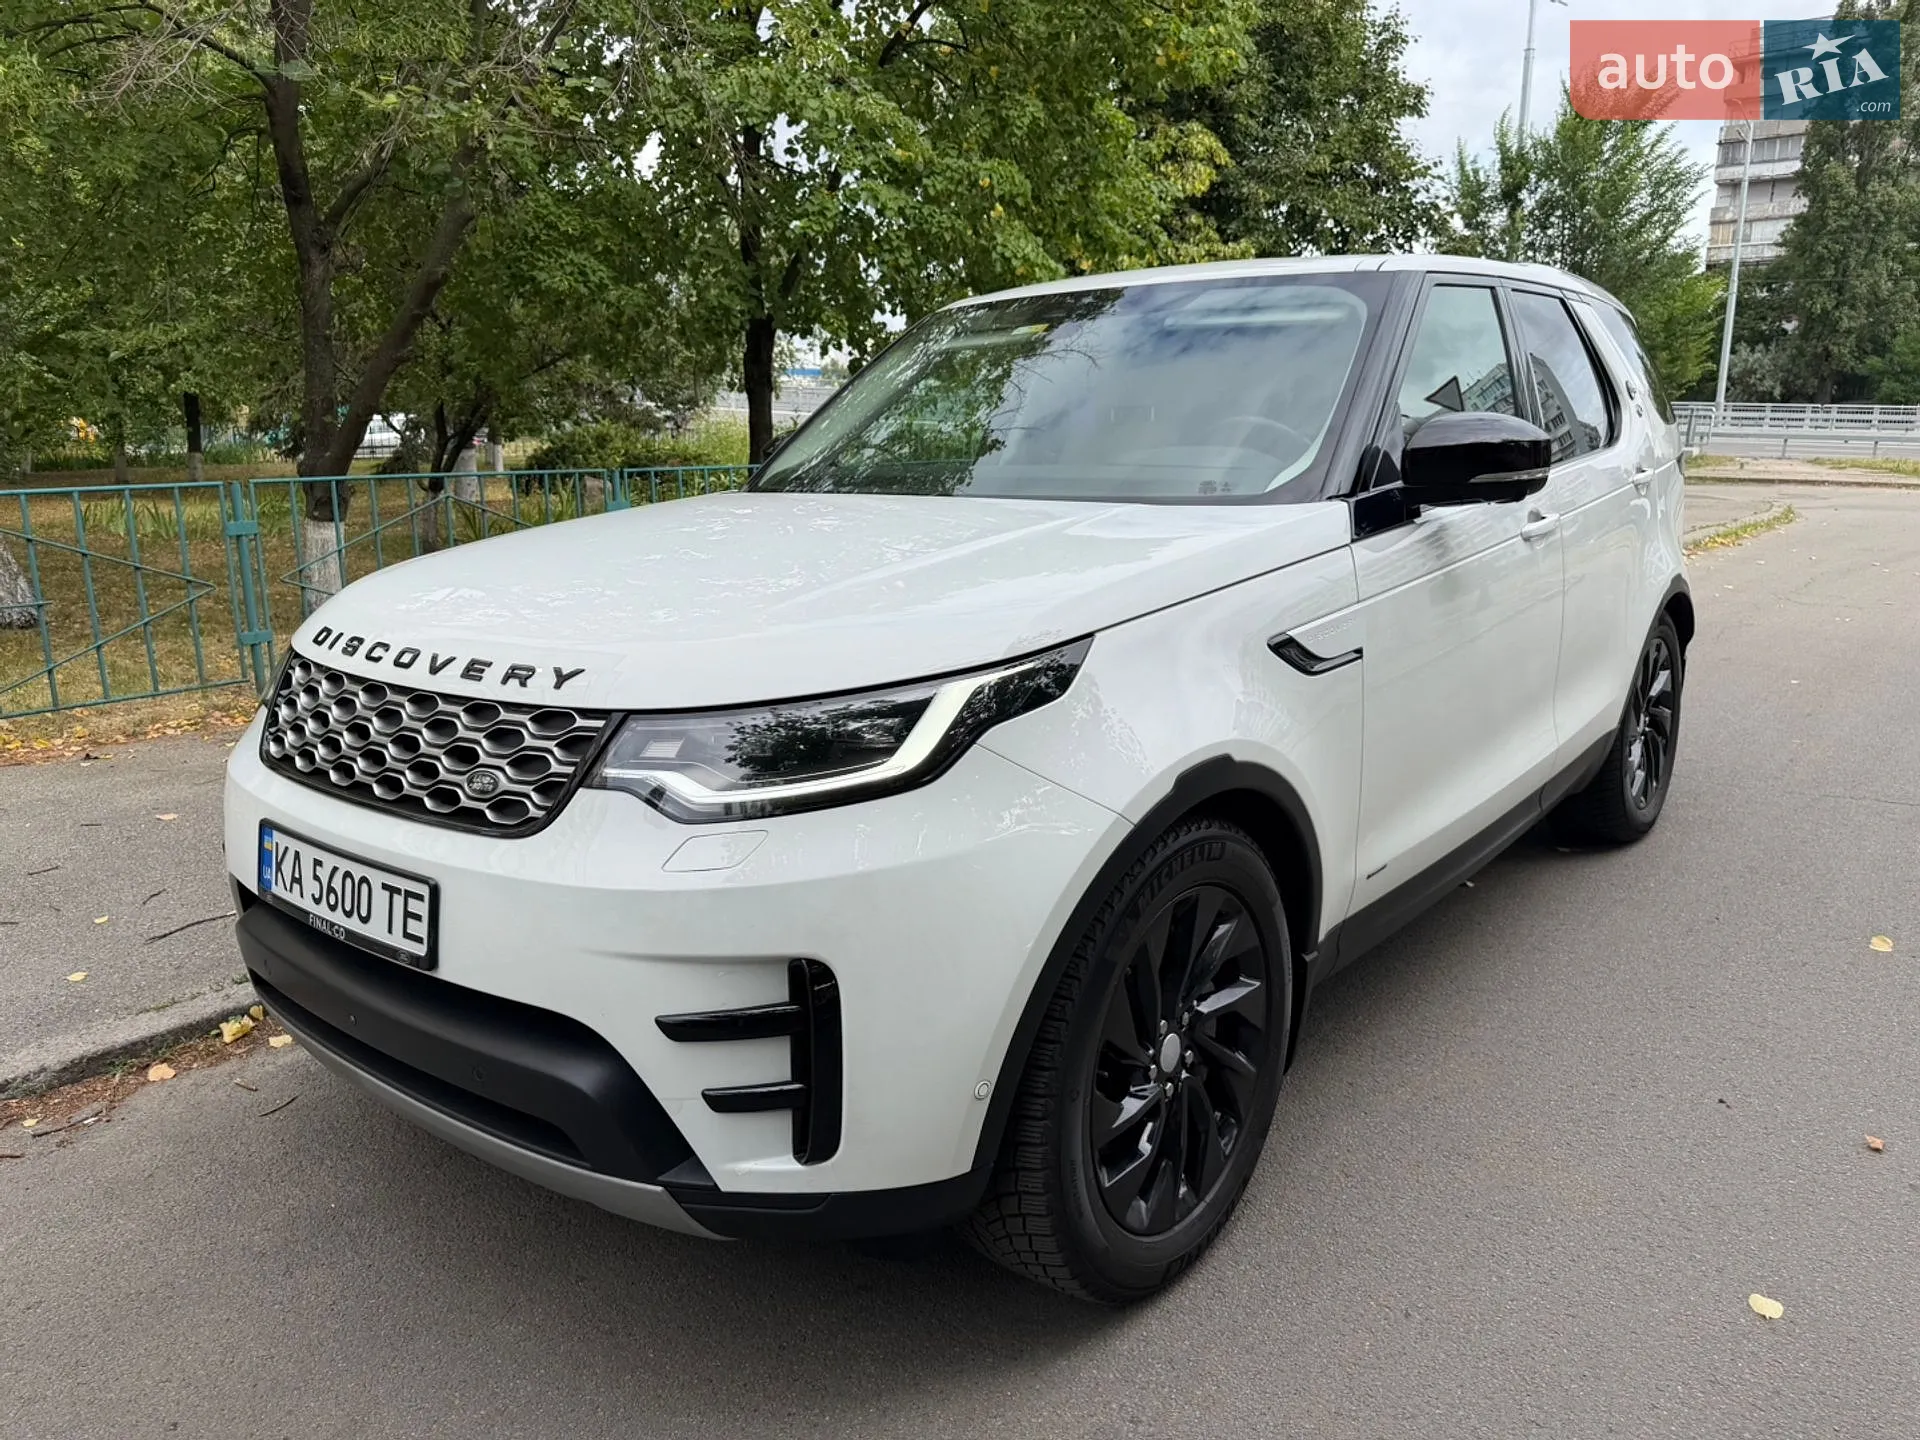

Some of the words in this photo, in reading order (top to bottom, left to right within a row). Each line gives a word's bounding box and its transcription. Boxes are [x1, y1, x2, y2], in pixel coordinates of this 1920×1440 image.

[312, 626, 586, 690] DISCOVERY
[262, 865, 272, 879] UA
[275, 841, 303, 899] KA
[311, 857, 373, 924] 5600
[381, 881, 425, 944] TE
[1132, 841, 1227, 916] MICHELIN
